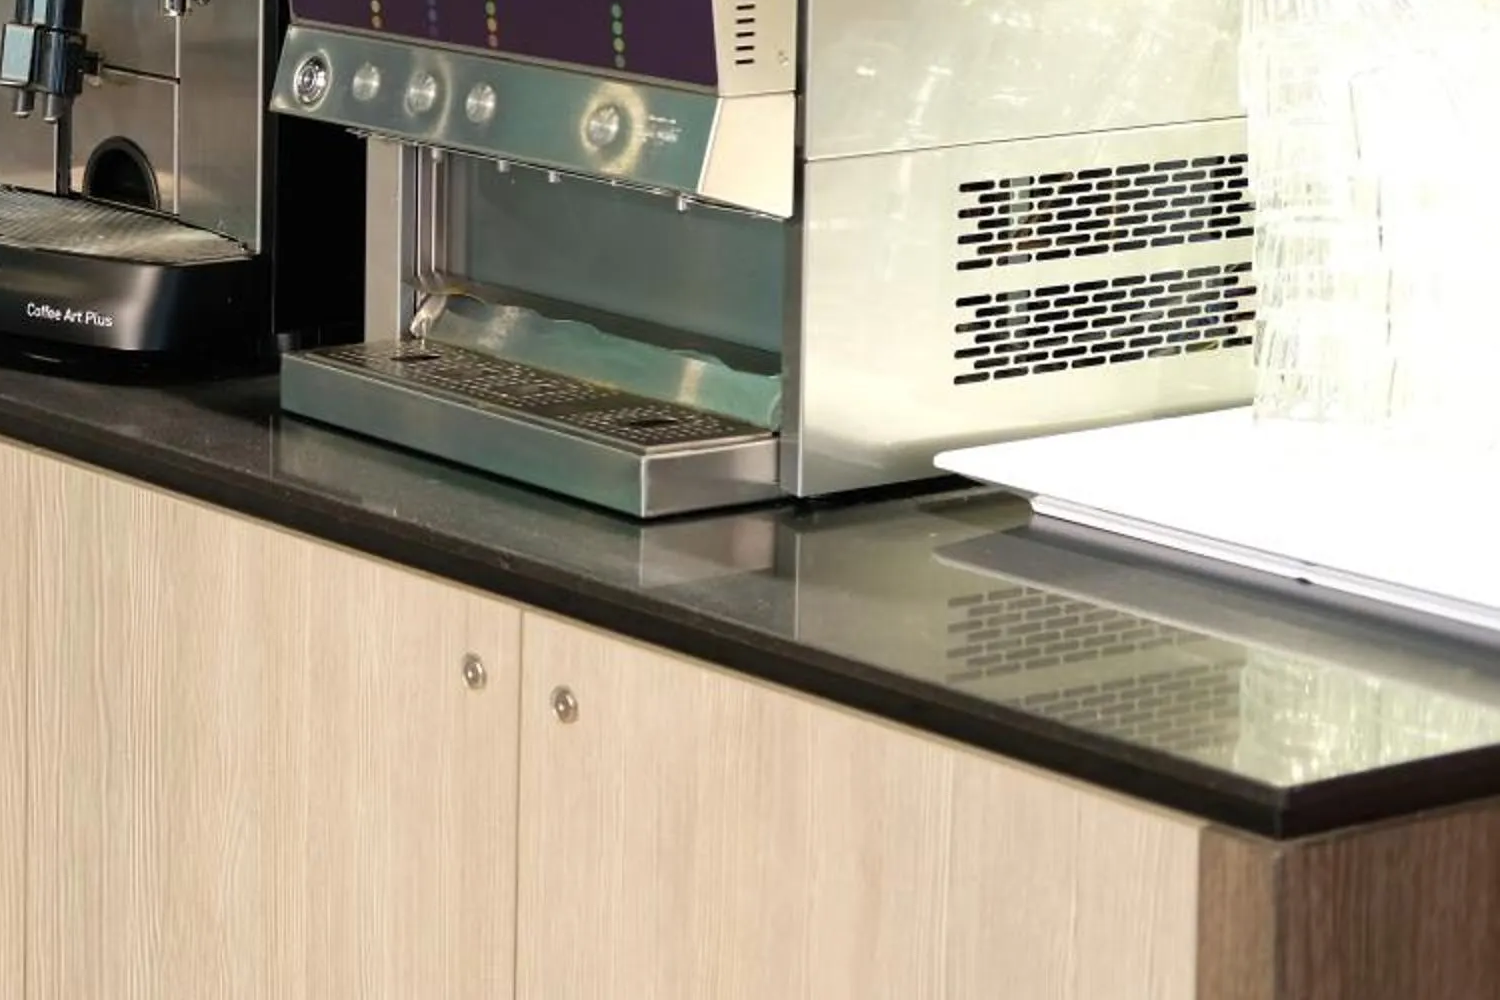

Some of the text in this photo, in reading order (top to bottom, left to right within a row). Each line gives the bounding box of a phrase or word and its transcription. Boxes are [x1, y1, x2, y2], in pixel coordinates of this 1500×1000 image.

[27, 302, 113, 327] Coffee Art Plus
